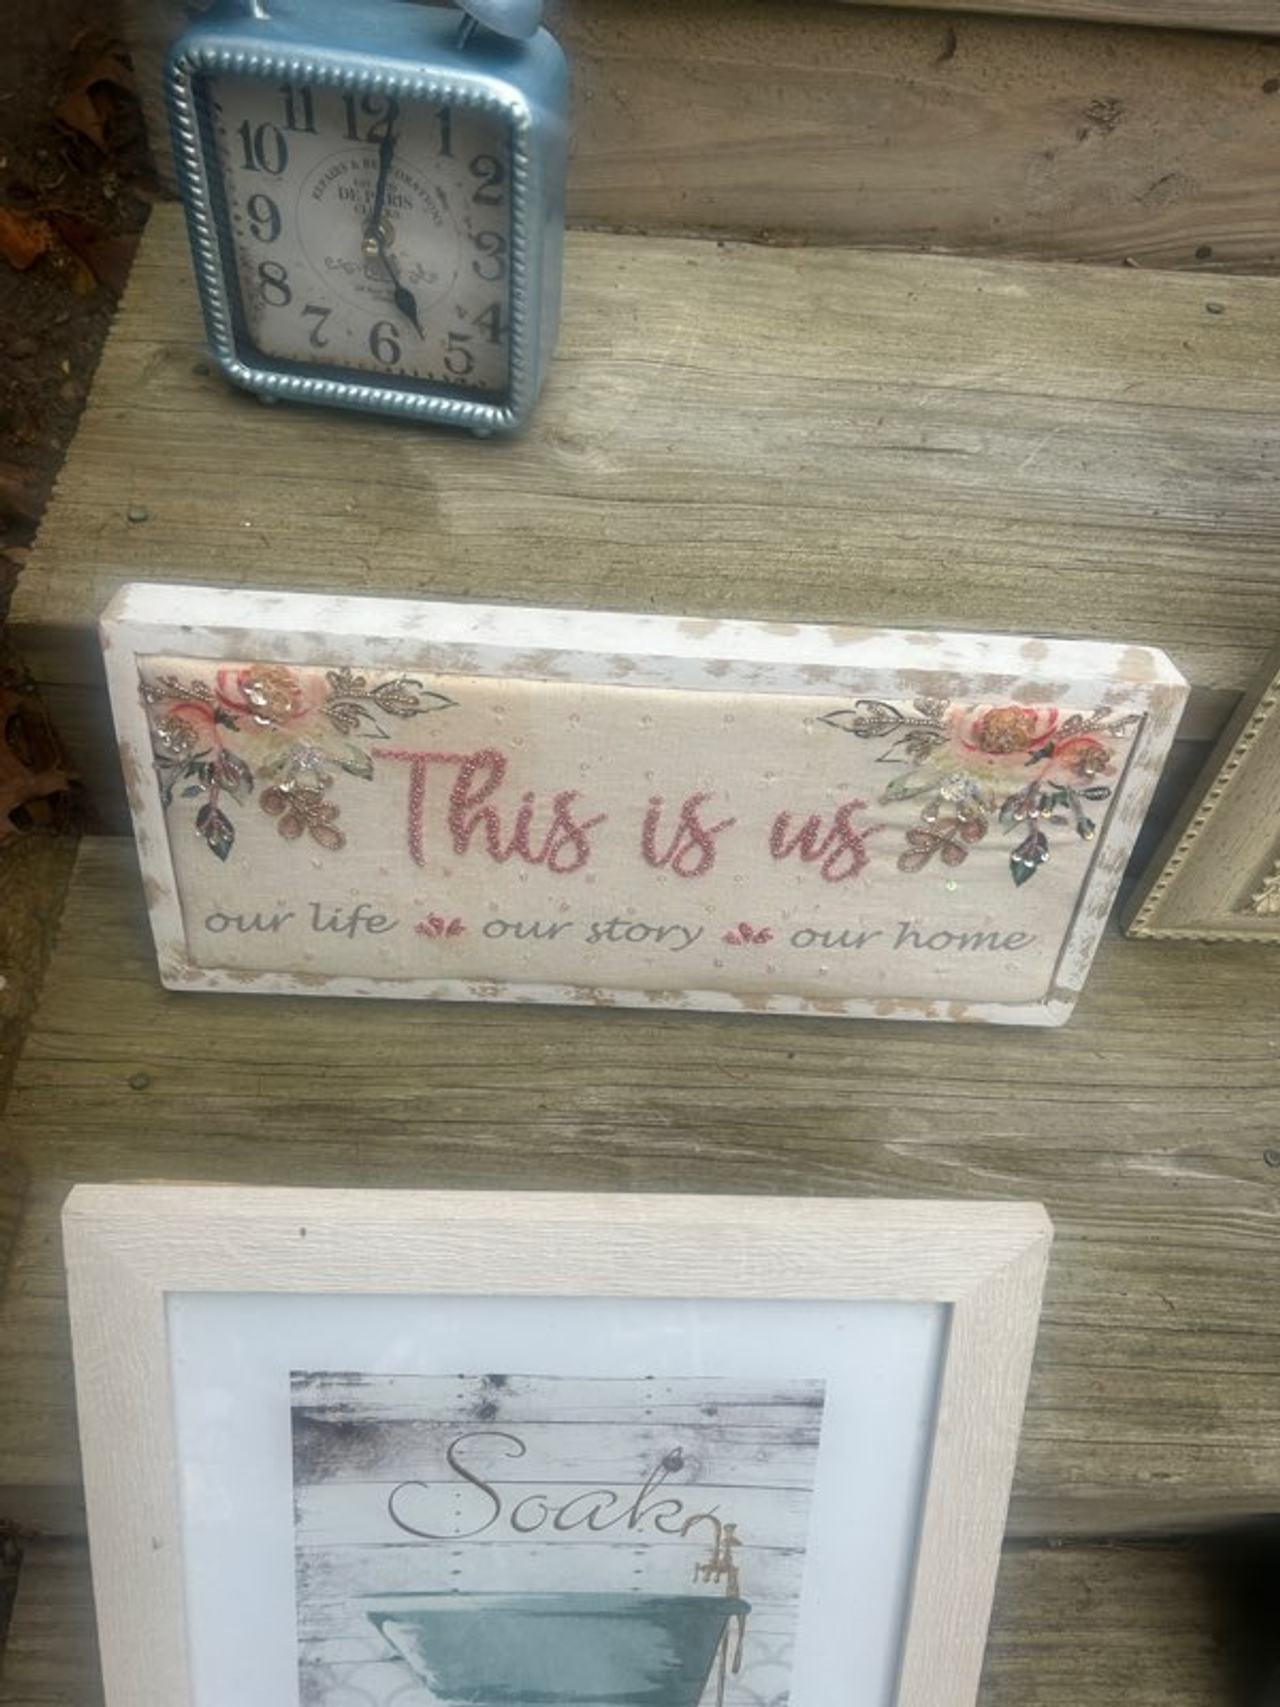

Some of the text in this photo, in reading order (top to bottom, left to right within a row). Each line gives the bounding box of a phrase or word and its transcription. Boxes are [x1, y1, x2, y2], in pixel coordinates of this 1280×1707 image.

[279, 82, 318, 134] 11
[342, 92, 398, 143] 12
[434, 104, 454, 157] 1
[237, 119, 288, 176] 10
[469, 154, 504, 206] 2
[247, 194, 282, 244] 9
[472, 231, 506, 282] 3
[257, 261, 292, 307] 8
[302, 304, 332, 349] 7
[369, 321, 399, 366] 6
[472, 302, 508, 344] 4
[443, 331, 474, 376] 5
[372, 747, 886, 882] This is us
[204, 902, 1037, 952] our life our story our home
[388, 1431, 720, 1540] Soak
